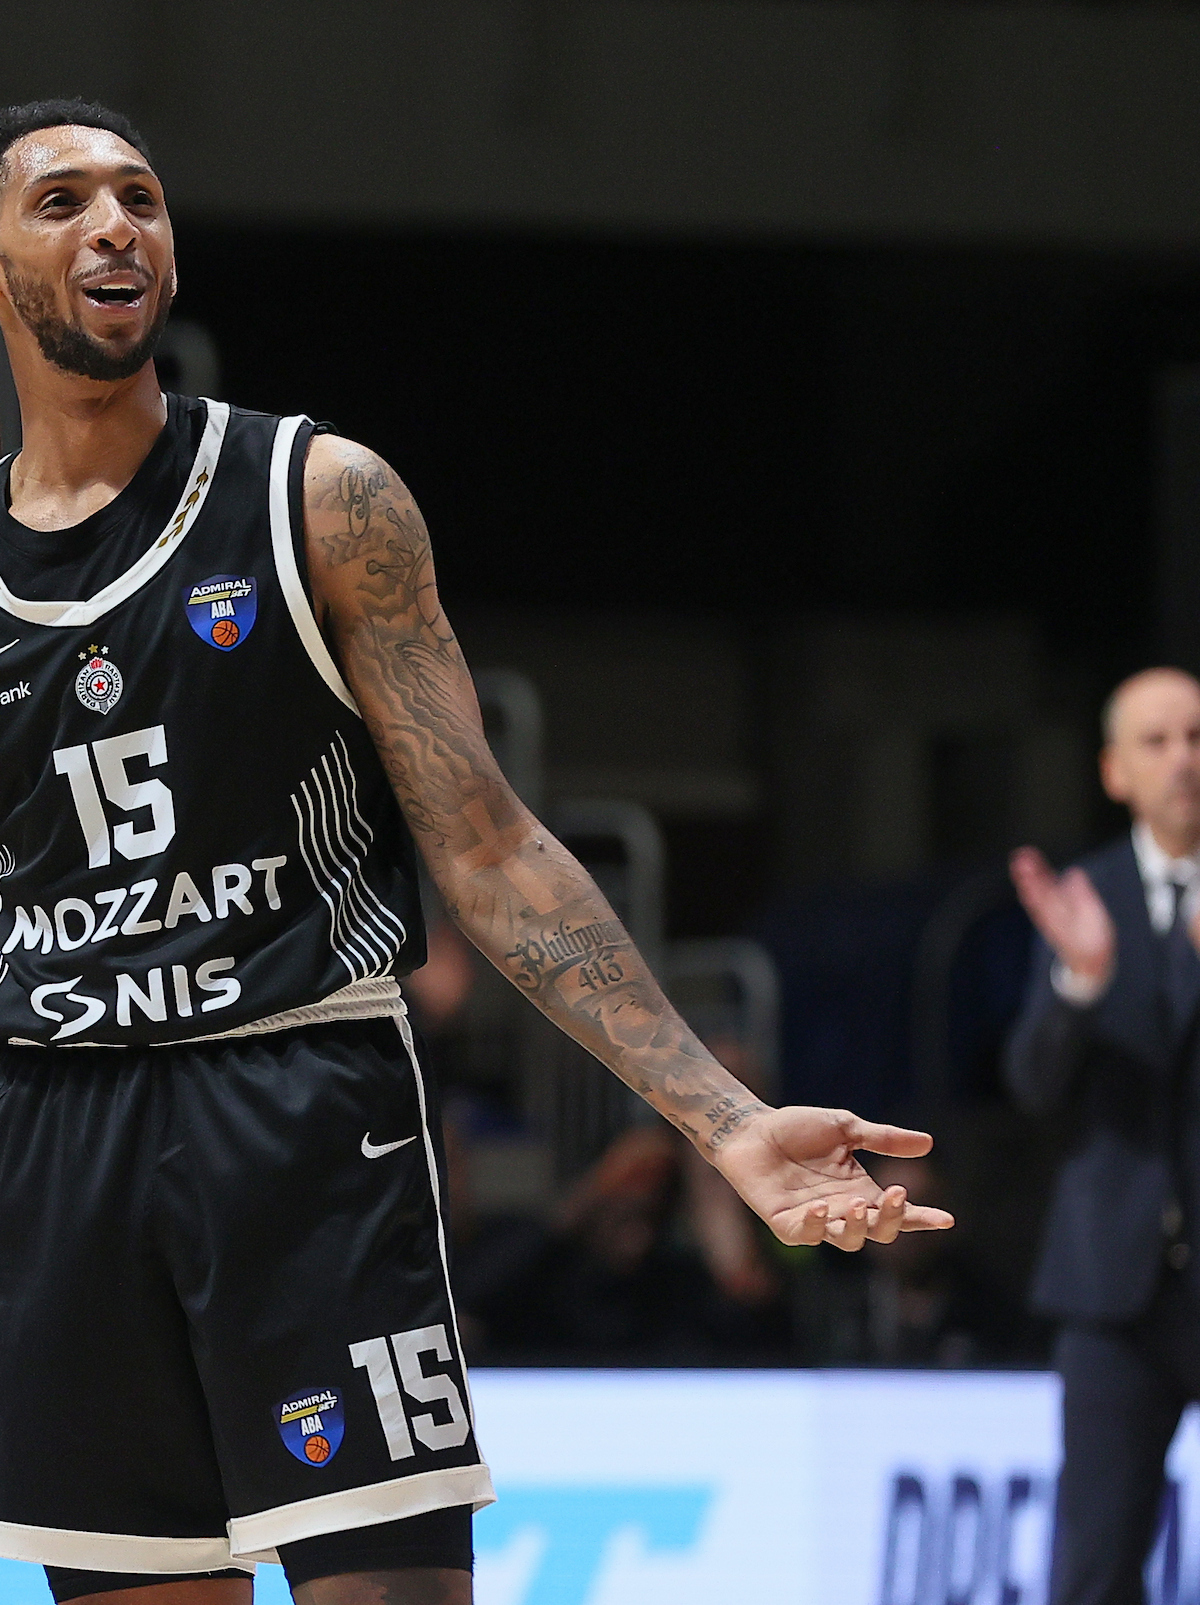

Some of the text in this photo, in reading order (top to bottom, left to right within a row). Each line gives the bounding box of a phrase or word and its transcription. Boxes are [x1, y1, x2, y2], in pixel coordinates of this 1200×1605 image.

[190, 578, 252, 598] ADMIRAL
[229, 588, 251, 599] BET
[211, 599, 235, 619] ABA
[52, 724, 176, 870] 15
[2, 855, 288, 956] MOZZART
[579, 953, 624, 991] 4:13
[115, 956, 242, 1027] NIS
[281, 1390, 338, 1415] ADMIRAL
[347, 1323, 470, 1462] 15
[300, 1414, 324, 1437] ABA
